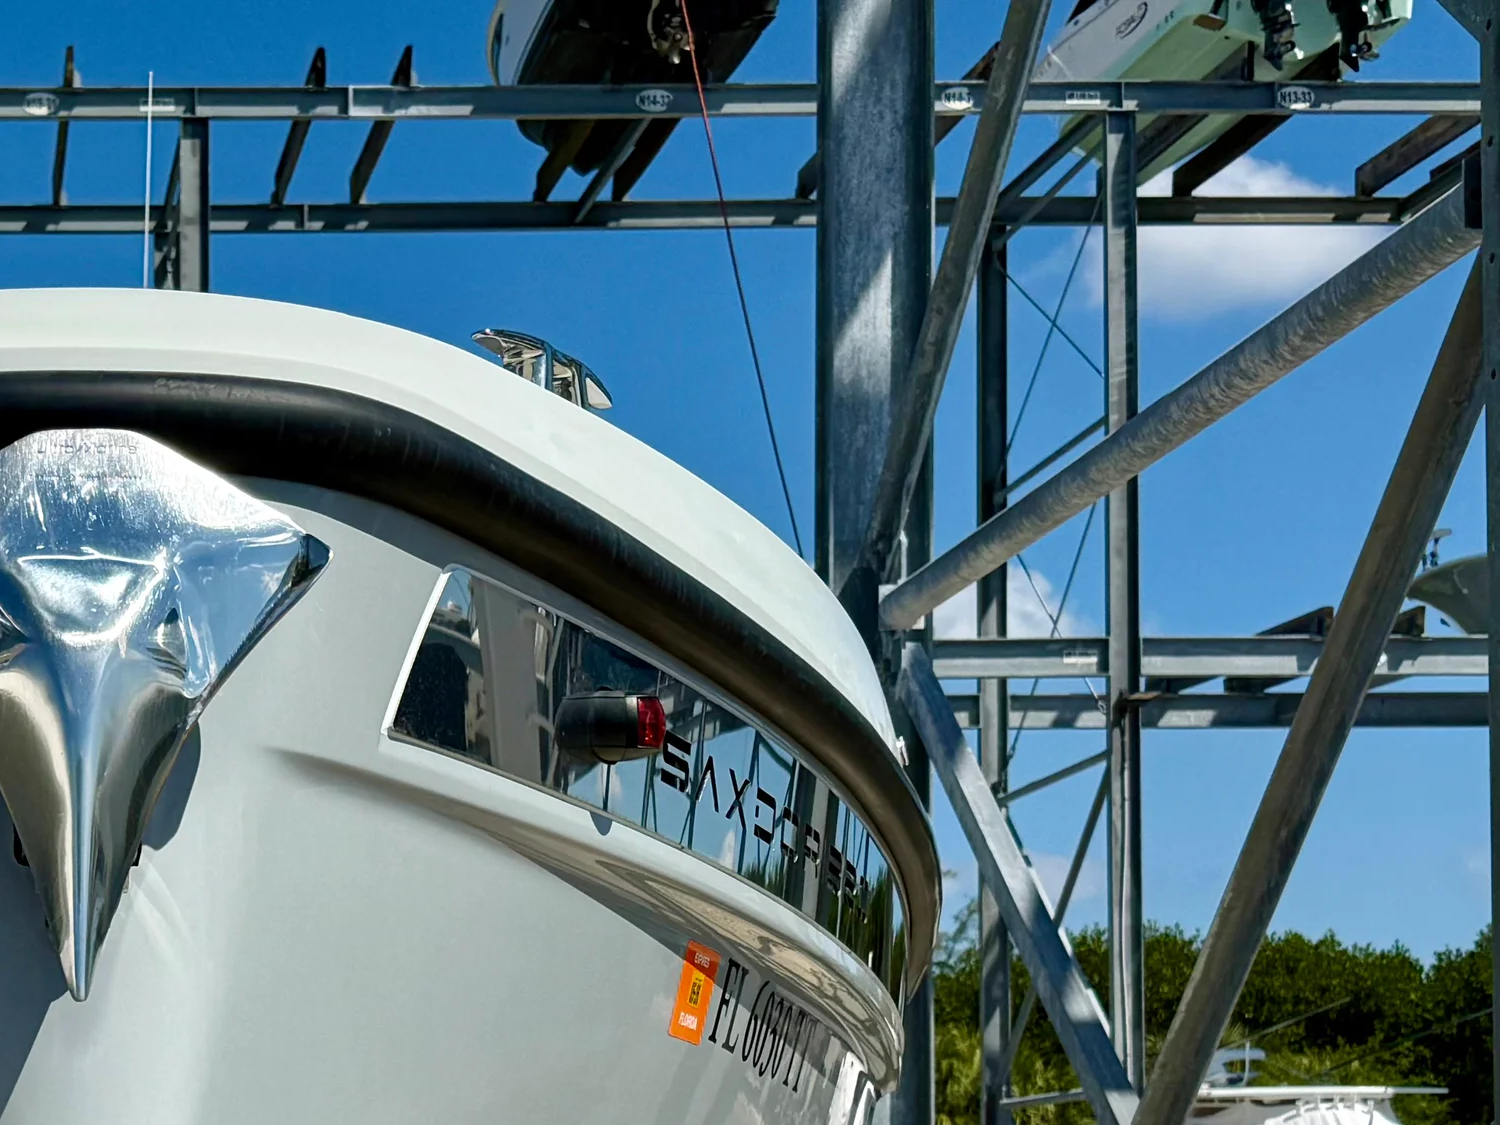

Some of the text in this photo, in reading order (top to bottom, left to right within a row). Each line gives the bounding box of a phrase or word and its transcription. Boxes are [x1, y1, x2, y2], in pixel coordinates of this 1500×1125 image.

[1280, 90, 1312, 104] N13-33
[660, 729, 821, 878] SAXDOR
[708, 957, 820, 1093] FL 6030 TT
